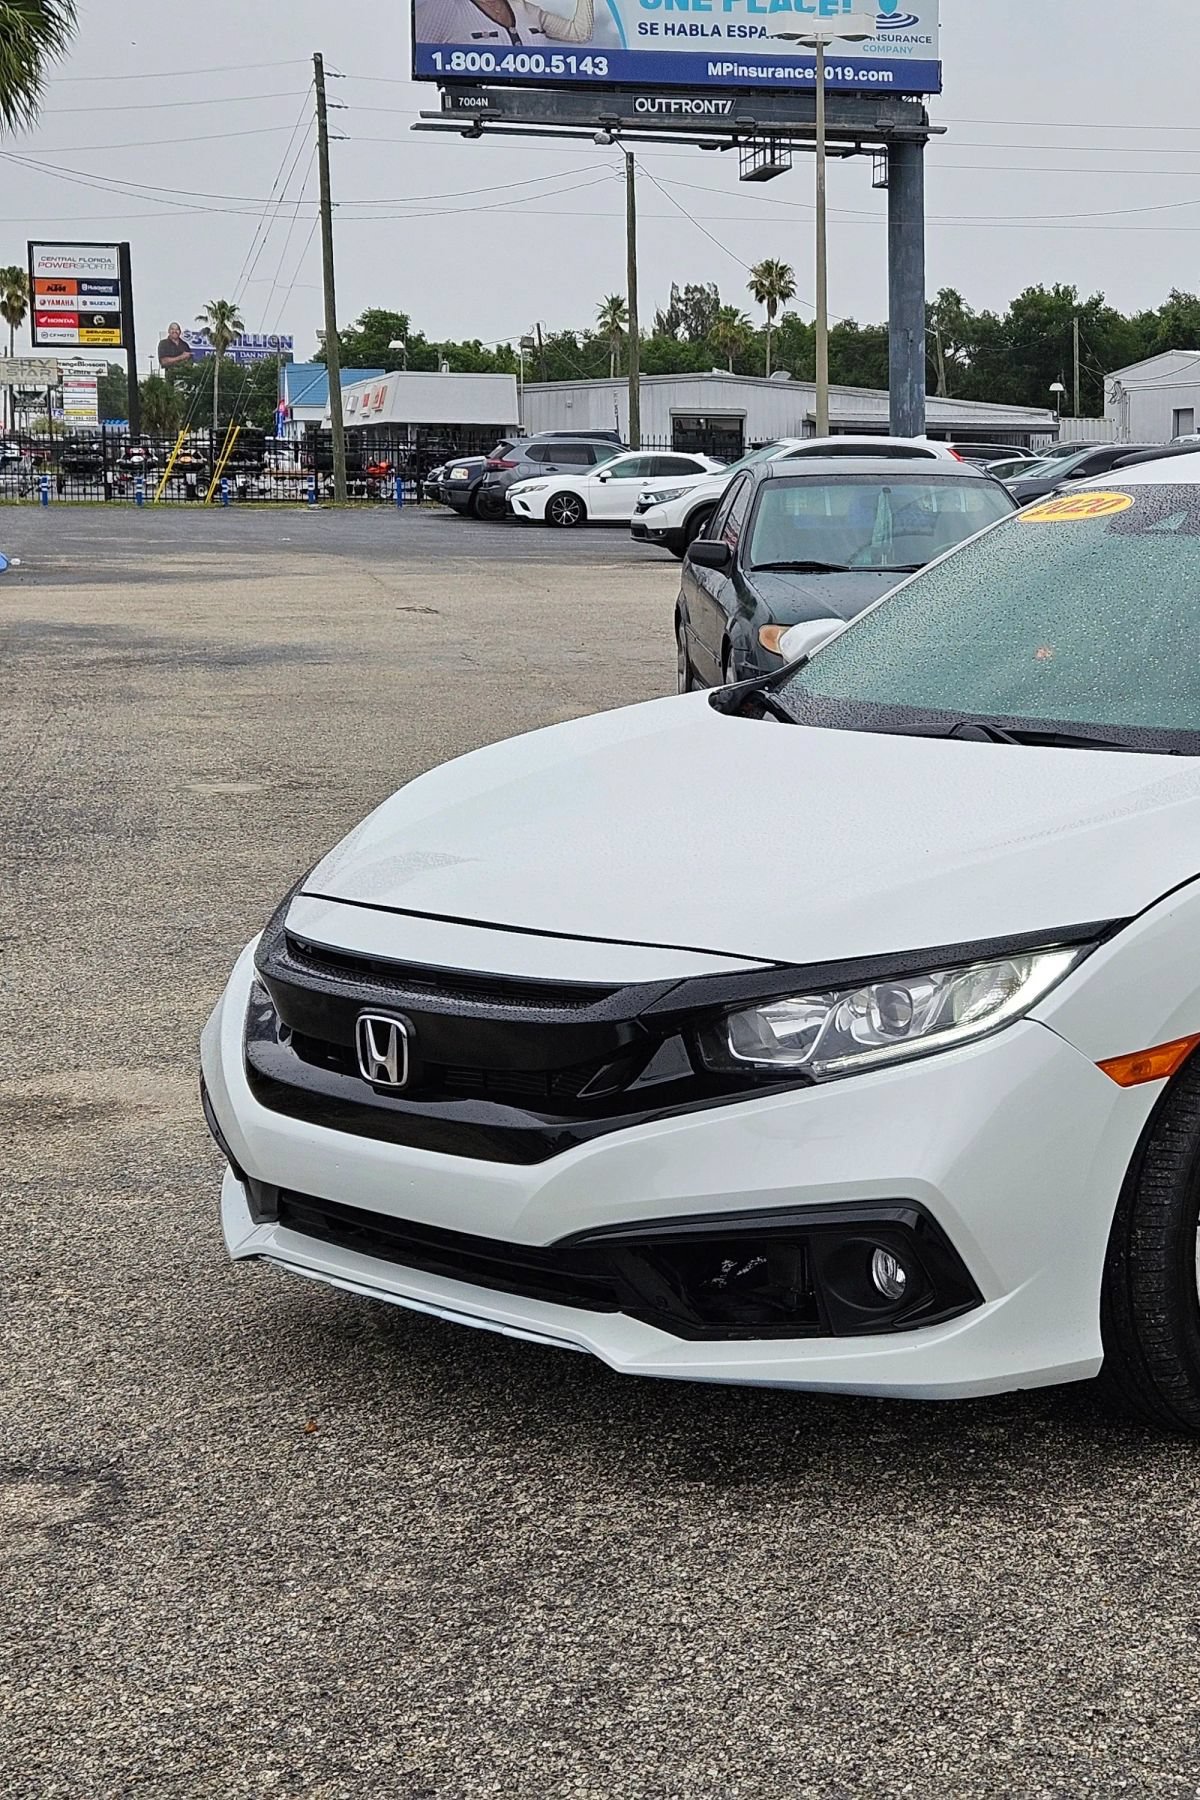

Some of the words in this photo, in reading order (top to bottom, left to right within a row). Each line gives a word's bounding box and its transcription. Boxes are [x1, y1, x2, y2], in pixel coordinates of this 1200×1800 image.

[638, 22, 659, 36] SE
[664, 23, 721, 37] HABLA
[726, 25, 788, 40] ESPA
[862, 45, 914, 54] COMPANY
[431, 51, 609, 76] 1.800.400.5143
[458, 97, 489, 107] 7004N
[37, 261, 115, 270] POWERSPORTS
[6, 359, 51, 368] CITY
[1022, 498, 1127, 516] 2020
